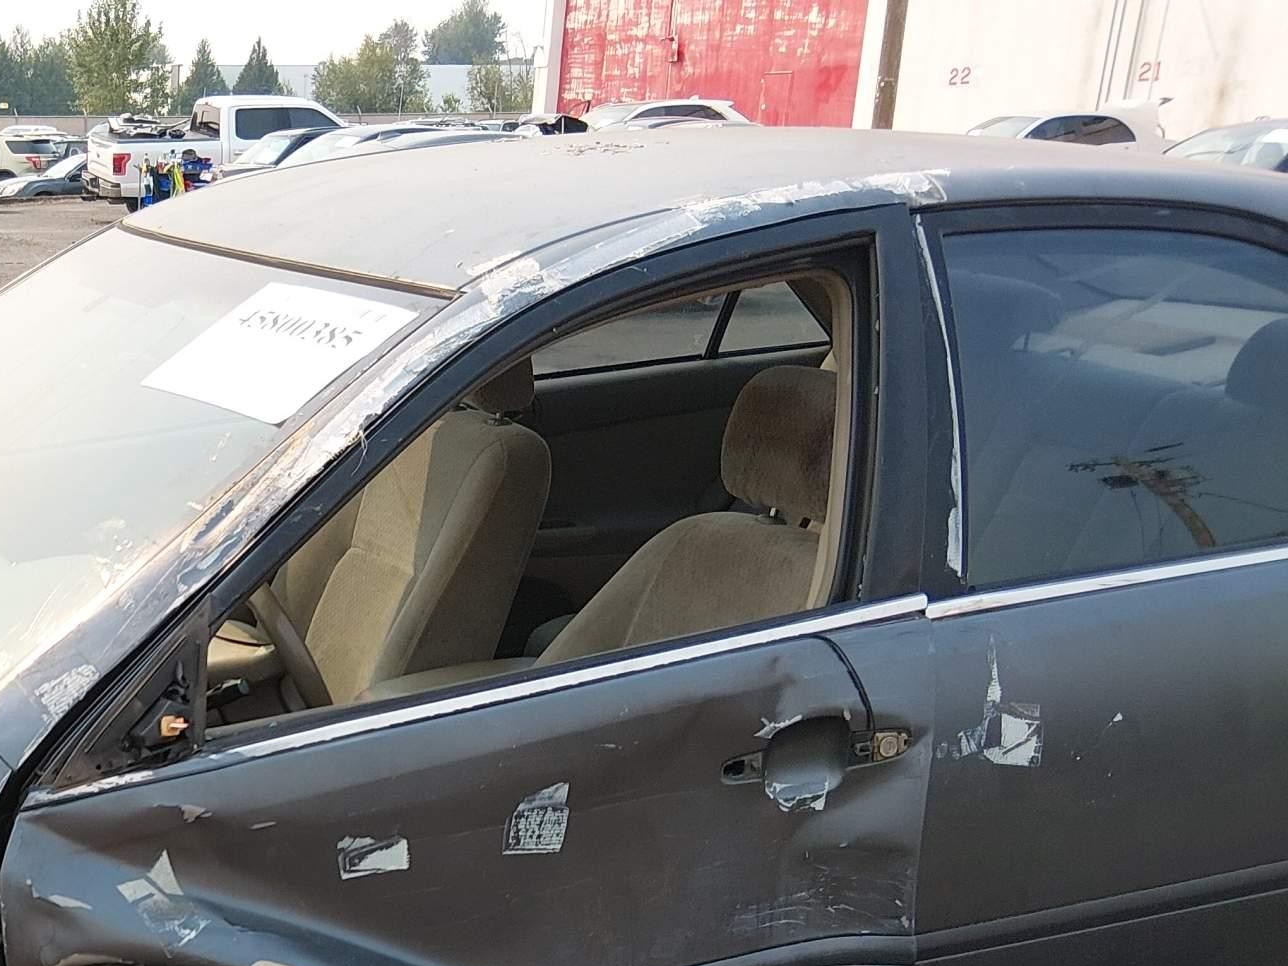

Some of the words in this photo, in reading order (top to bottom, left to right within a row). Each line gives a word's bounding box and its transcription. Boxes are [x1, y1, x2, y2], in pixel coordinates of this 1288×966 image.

[948, 66, 972, 86] 22
[1137, 61, 1161, 82] 21
[239, 310, 363, 348] 45800385
